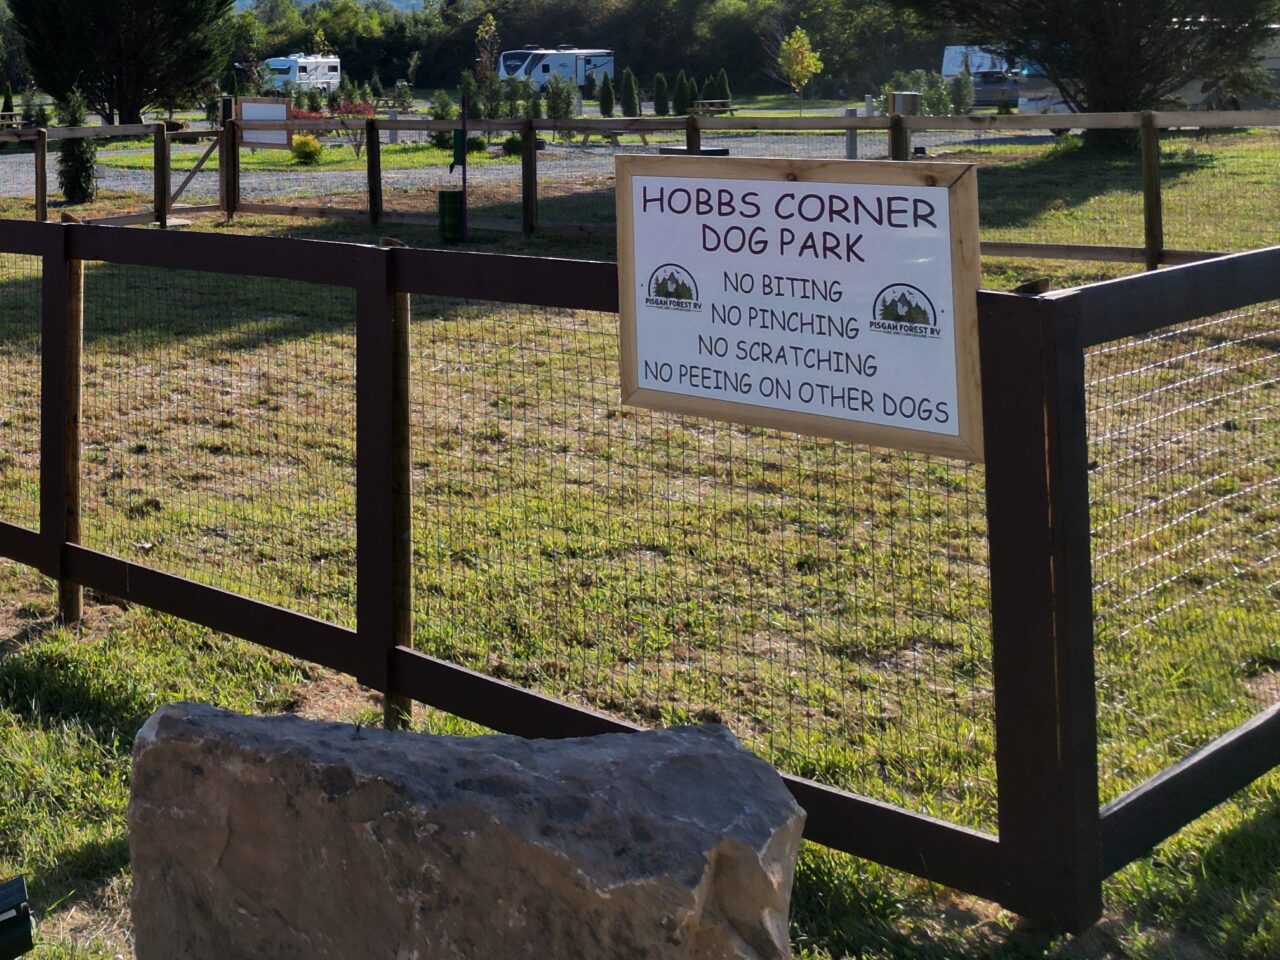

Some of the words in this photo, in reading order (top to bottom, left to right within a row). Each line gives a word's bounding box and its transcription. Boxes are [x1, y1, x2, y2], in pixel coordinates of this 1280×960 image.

[642, 185, 761, 219] HOBBS
[774, 192, 938, 229] CORNER
[701, 223, 769, 255] DOG
[779, 227, 866, 263] PARK
[645, 298, 668, 306] PISGAH
[669, 300, 692, 308] FOREST
[723, 271, 755, 294] NO
[762, 273, 843, 303] BITING
[711, 302, 742, 326] NO
[748, 306, 860, 340] PINCHING
[869, 321, 898, 331] PISGAH
[899, 324, 928, 334] FOREST
[930, 328, 942, 336] RV
[698, 334, 729, 358] NO
[735, 340, 878, 378] SCRATCHING
[644, 359, 673, 383] NO
[678, 363, 753, 395] PEEING
[759, 376, 792, 401] ON
[798, 381, 875, 413] OTHER
[882, 392, 950, 424] DOGS
